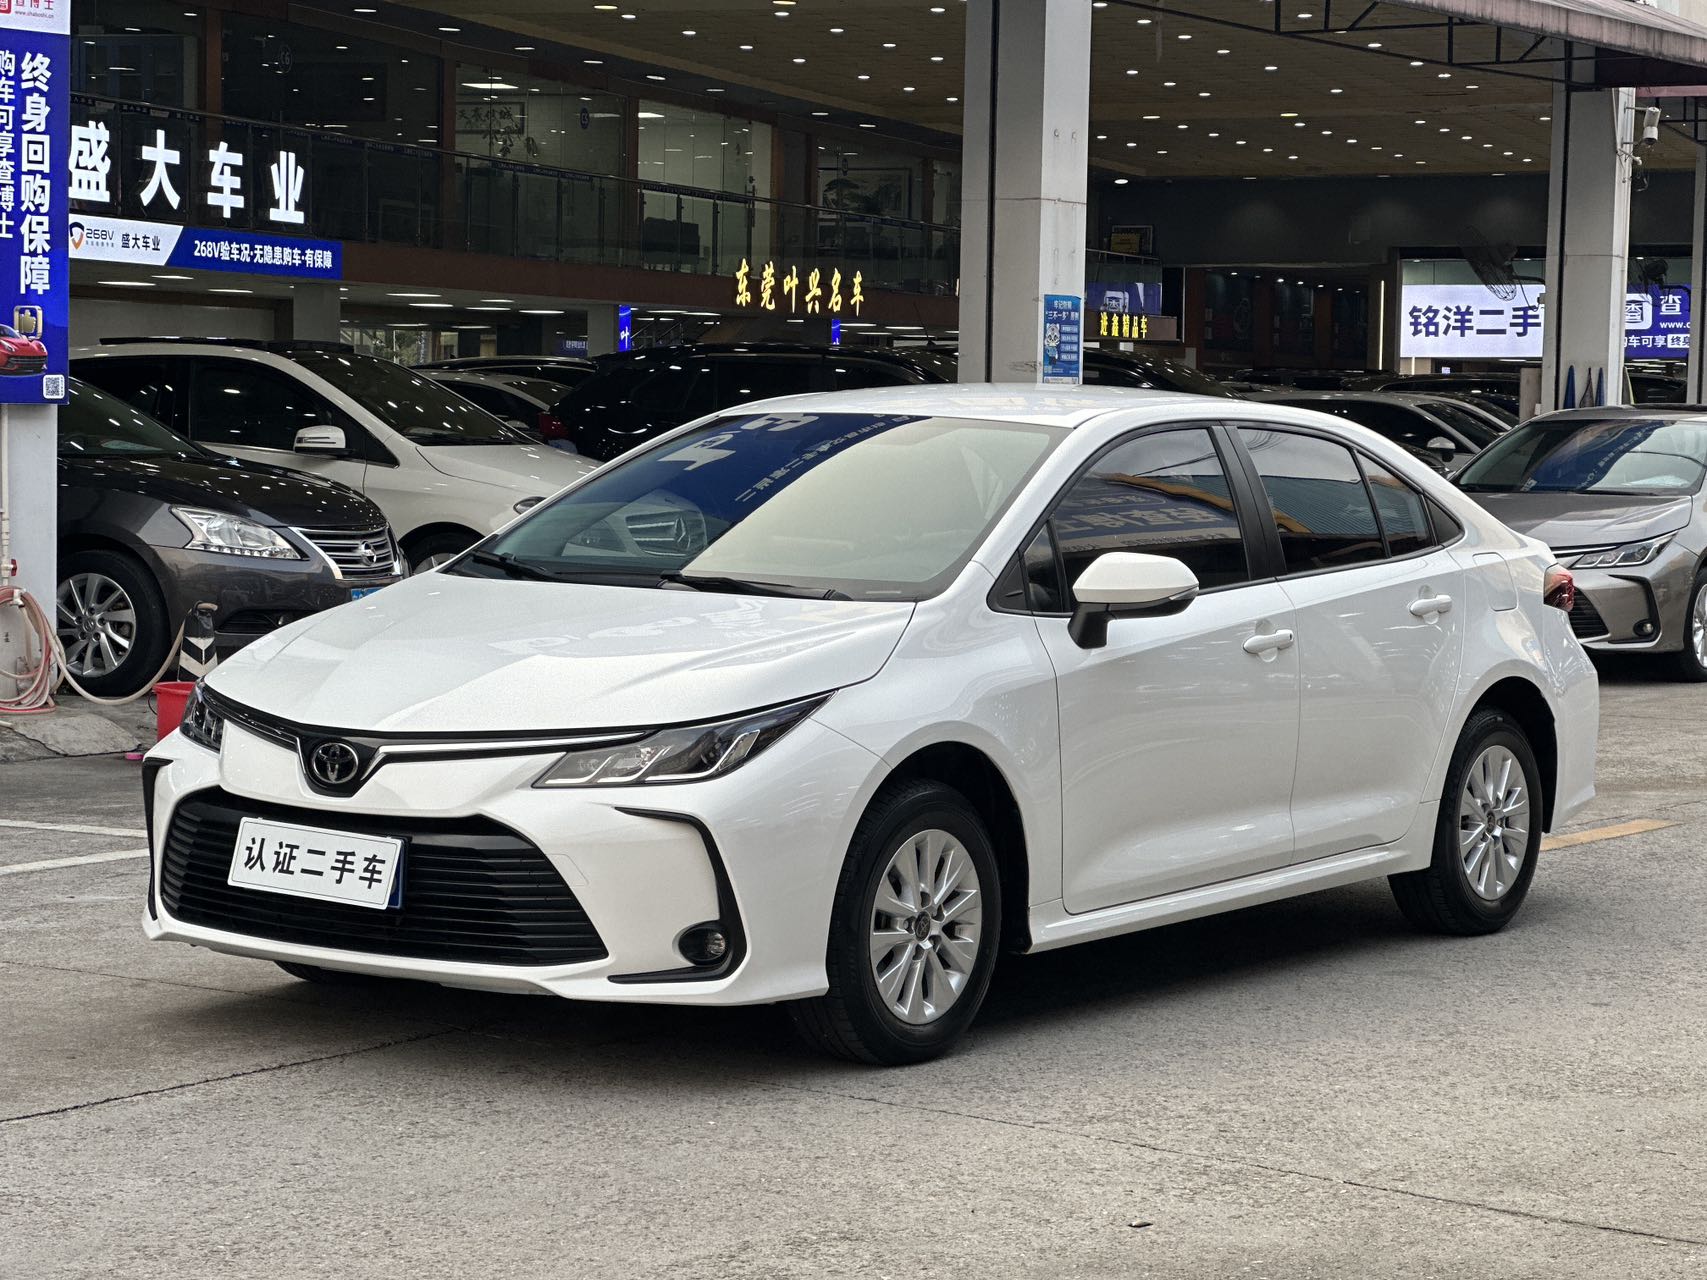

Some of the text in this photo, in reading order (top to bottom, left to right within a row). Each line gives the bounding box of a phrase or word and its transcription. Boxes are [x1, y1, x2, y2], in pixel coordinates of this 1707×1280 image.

[21, 51, 52, 295] 终身回购保障
[68, 120, 305, 224] 盛大车业
[86, 228, 115, 241] 268V
[121, 232, 161, 252] 盛大车业
[1408, 304, 1542, 338] 铭洋二手
[244, 837, 386, 890] 认证二手车
